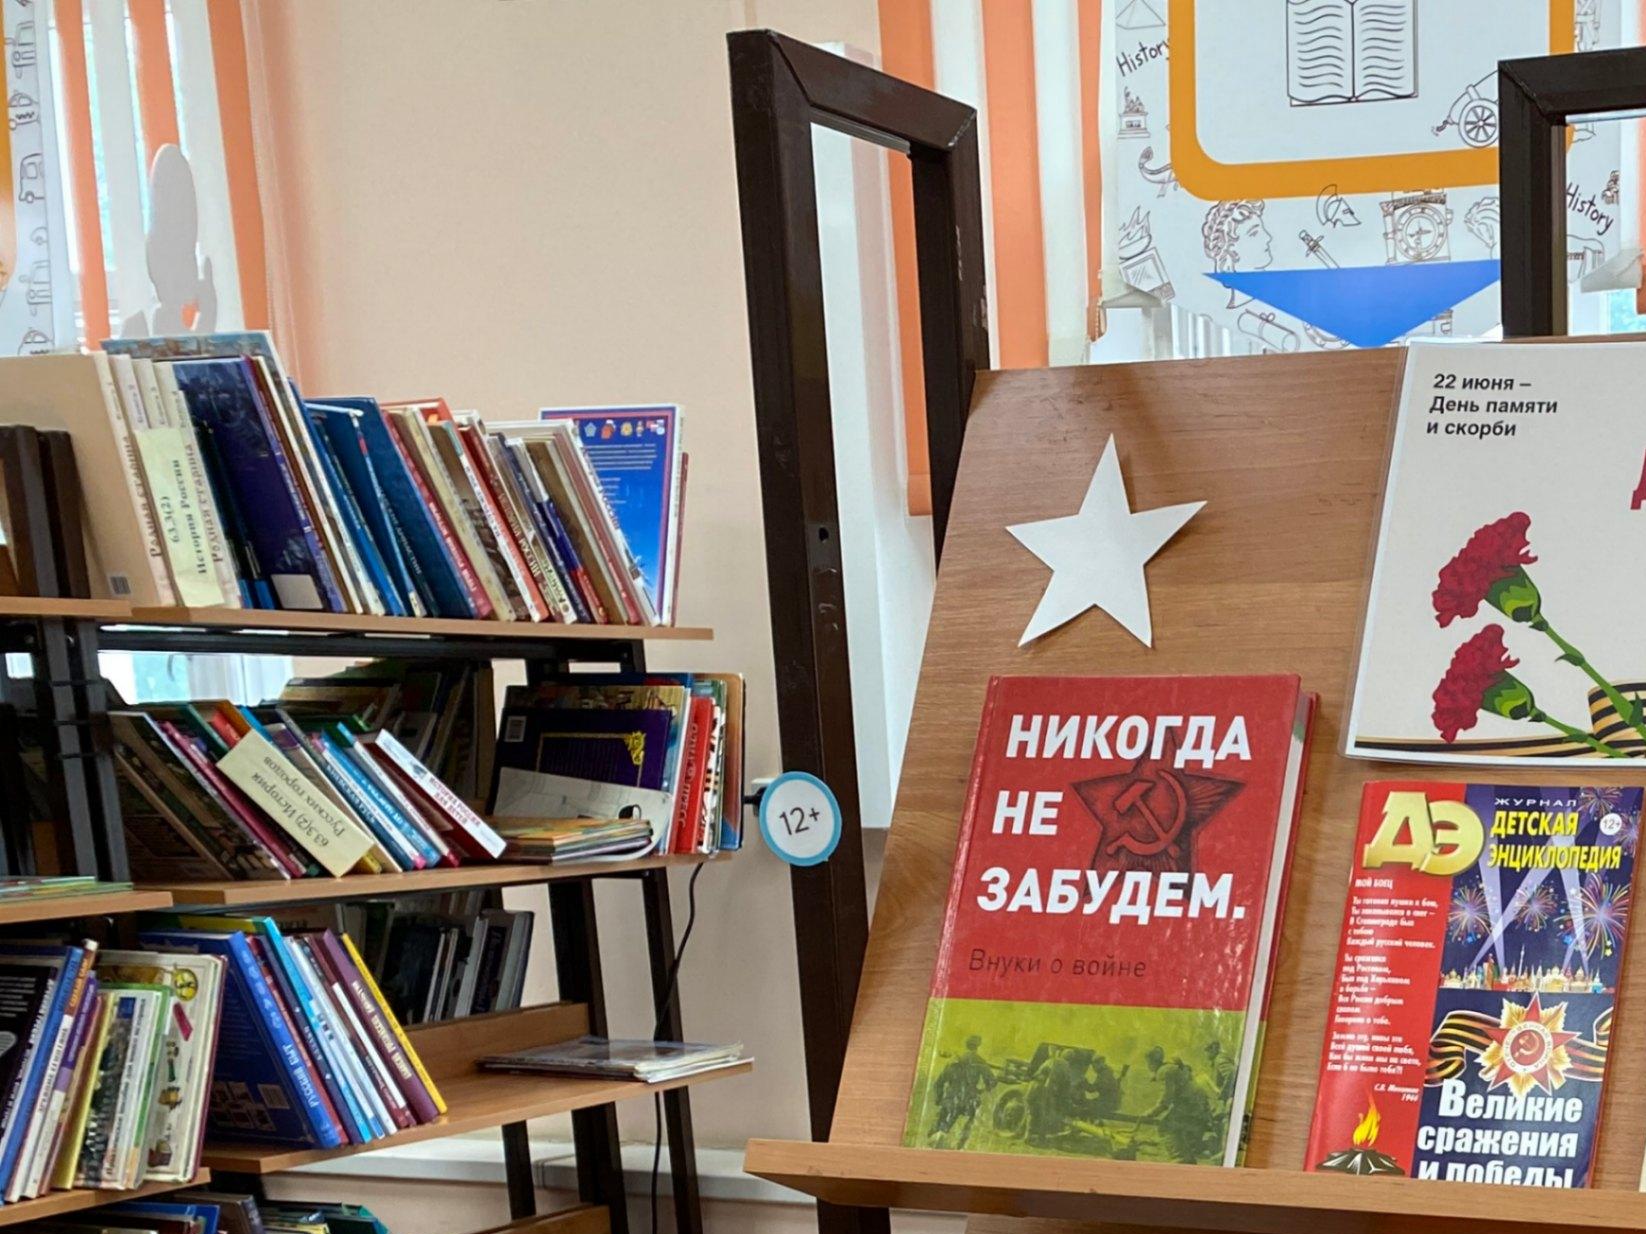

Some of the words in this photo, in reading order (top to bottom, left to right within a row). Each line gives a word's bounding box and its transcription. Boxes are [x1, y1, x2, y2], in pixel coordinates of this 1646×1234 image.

[1433, 373, 1457, 390] 22
[1461, 376, 1515, 393] июня
[1429, 395, 1480, 417] День
[1485, 398, 1558, 415] памяти
[1426, 421, 1439, 435] и
[1444, 418, 1517, 440] скорби
[173, 460, 191, 509] России
[186, 514, 207, 574] История
[1005, 714, 1252, 769] НИКОГДА
[252, 772, 296, 813] История
[263, 756, 306, 796] городов
[303, 794, 345, 838] Русских
[779, 807, 820, 835] 12+
[992, 790, 1064, 836] НЕ
[1494, 797, 1578, 807] ЖУРНАЛ
[1362, 791, 1485, 876] ДЭ
[1490, 811, 1579, 839] ДЕТСКАЯ
[1602, 818, 1622, 831] 12+
[1487, 843, 1622, 873] ЭНЦИКЛОПЕДИЯ
[977, 866, 1245, 925] ЗАБУДЕМ.
[968, 948, 1042, 979] Внуки
[1051, 959, 1062, 975] о
[1071, 954, 1147, 979] войне
[1438, 1078, 1583, 1123] Великие
[1416, 1125, 1579, 1159] сражения
